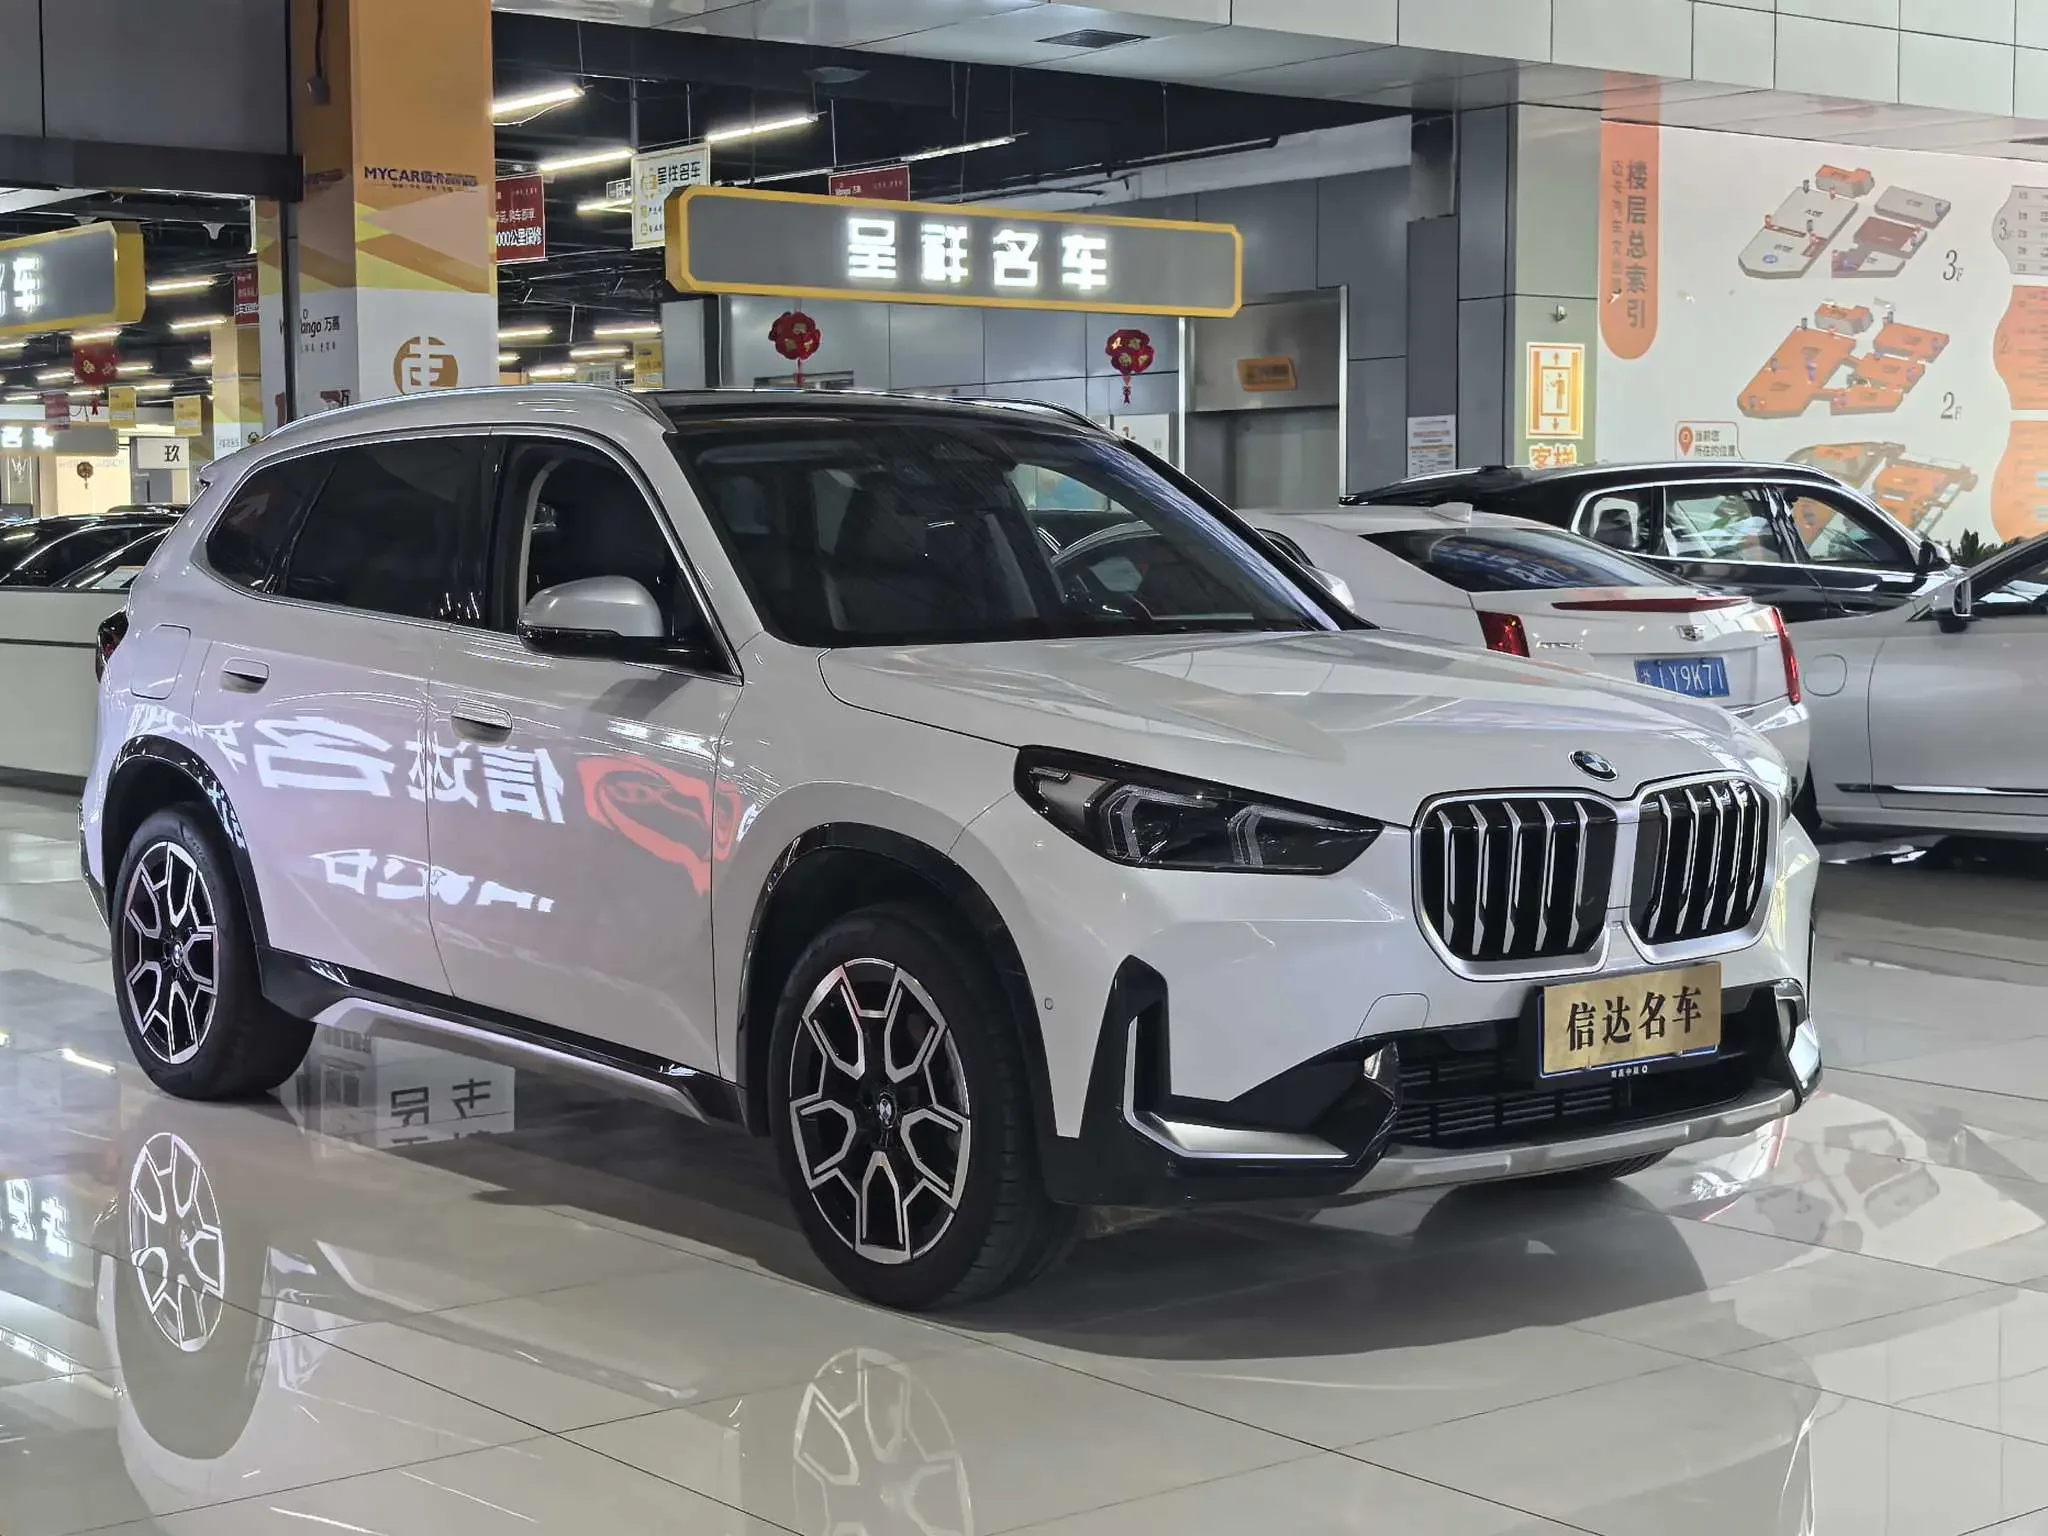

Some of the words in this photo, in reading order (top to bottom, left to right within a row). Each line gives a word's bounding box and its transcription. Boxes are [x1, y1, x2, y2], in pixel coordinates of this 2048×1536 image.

[364, 166, 422, 184] MYCAR
[657, 161, 700, 185] 呈祥名车
[848, 216, 1108, 291] 呈祥名车
[1626, 160, 1647, 328] 楼层总索引
[1566, 985, 1702, 1052] 信达名车
